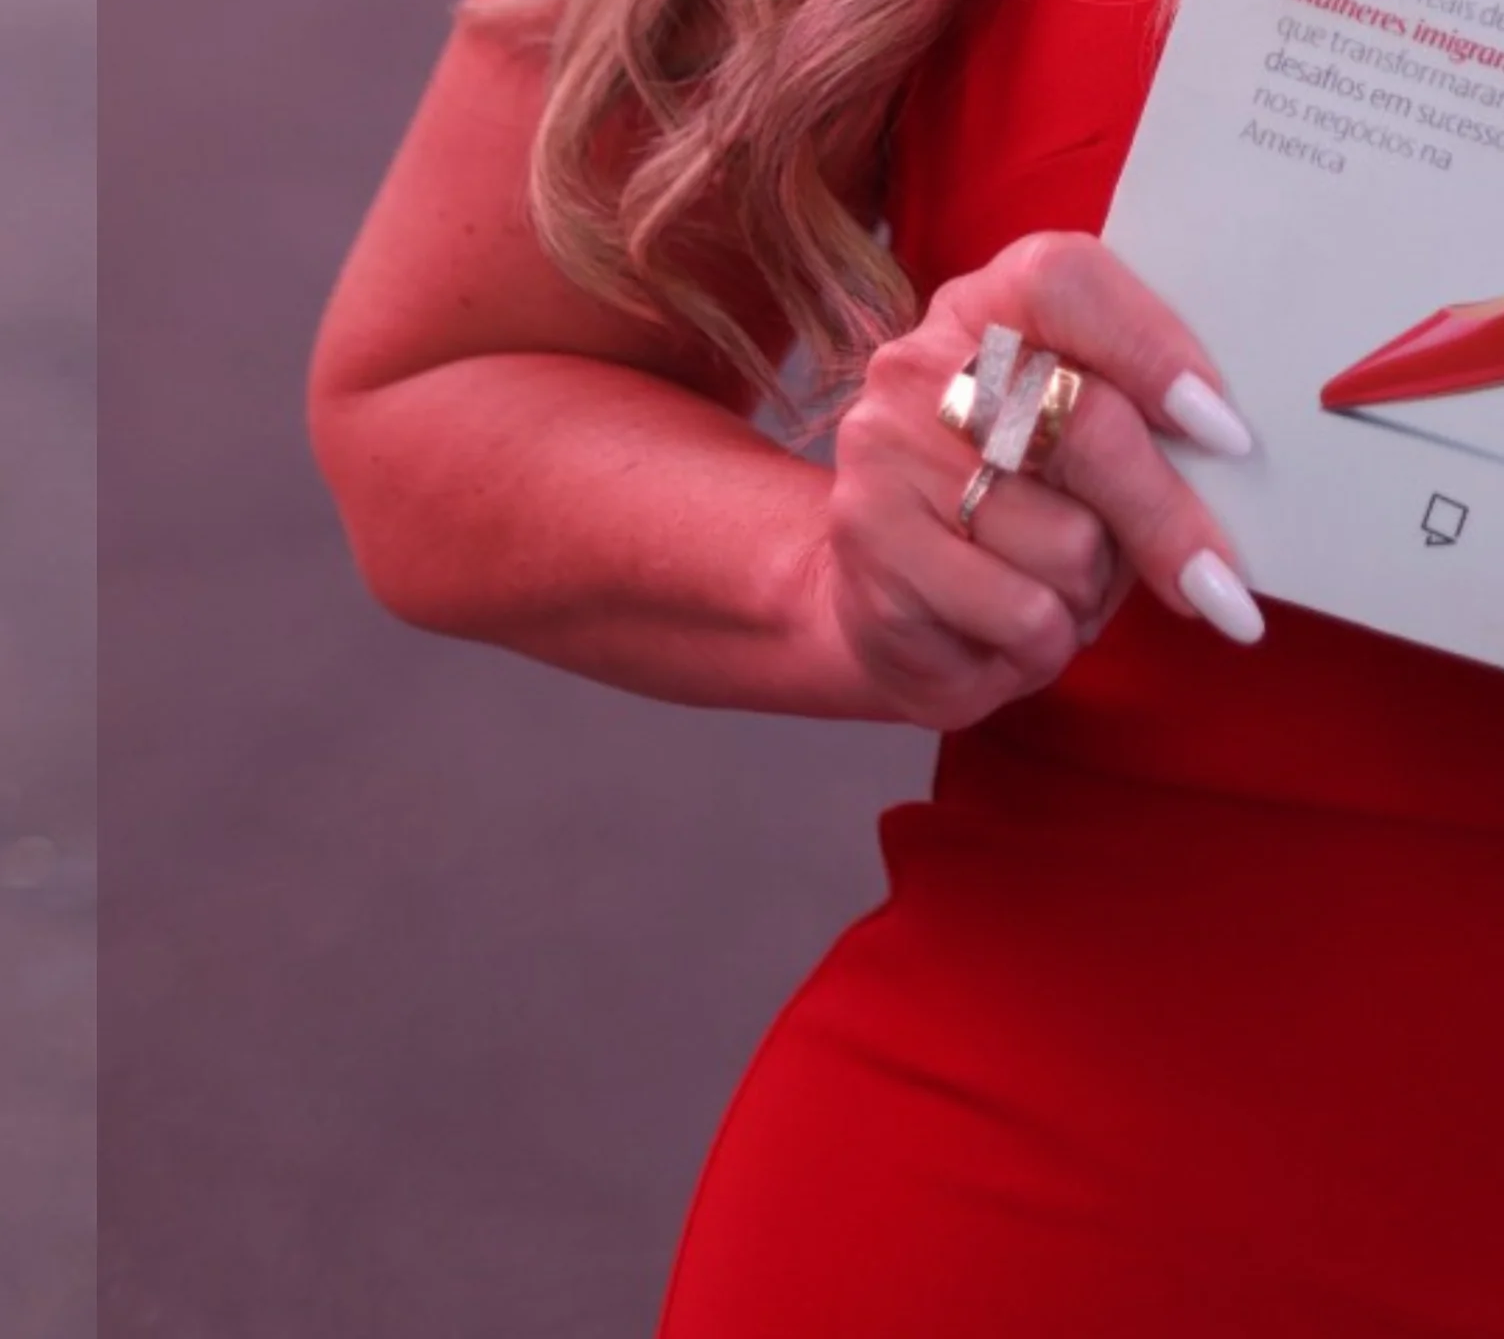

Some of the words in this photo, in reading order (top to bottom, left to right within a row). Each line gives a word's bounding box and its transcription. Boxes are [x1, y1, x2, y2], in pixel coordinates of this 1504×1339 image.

[1276, 13, 1327, 45] que
[1264, 46, 1367, 103] desafios
[1368, 86, 1413, 119] em
[1252, 85, 1299, 120] nos
[1419, 141, 1453, 172] na
